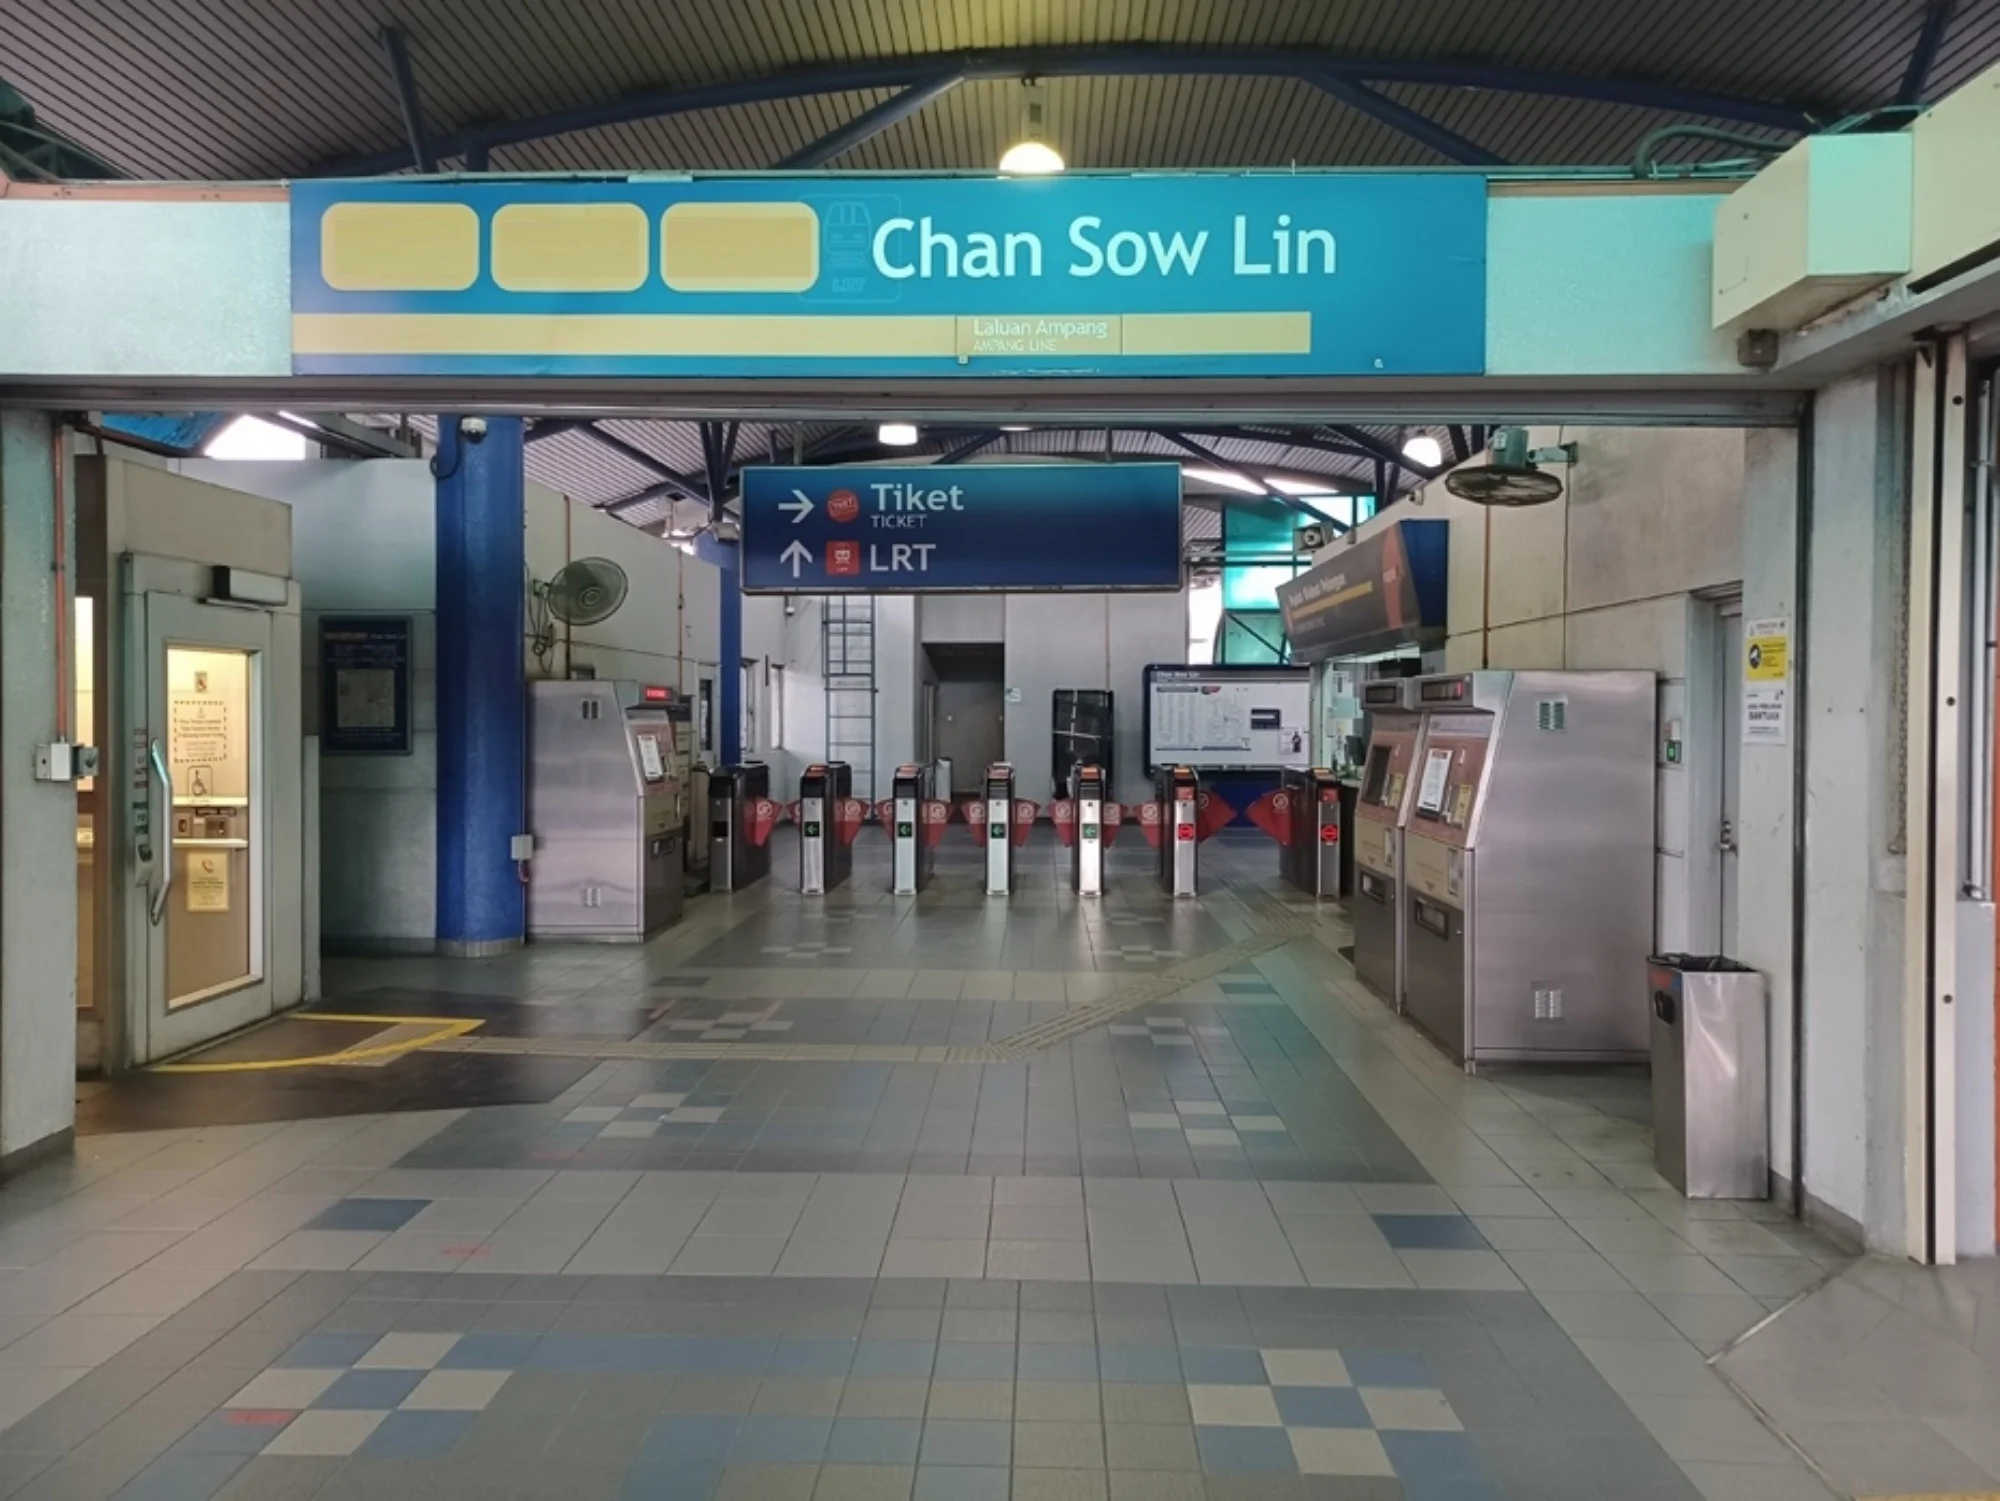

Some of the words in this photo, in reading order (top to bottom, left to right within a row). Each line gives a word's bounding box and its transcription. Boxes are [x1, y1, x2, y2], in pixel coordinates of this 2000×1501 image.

[872, 217, 1042, 279] Chan
[1068, 215, 1208, 277] Sow
[1233, 214, 1337, 275] Lin
[973, 319, 1031, 336] Laluan
[1035, 319, 1108, 339] Ampang
[973, 339, 1024, 352] AMPANG
[1029, 339, 1057, 352] LINE
[870, 483, 965, 512] Tiket
[870, 514, 928, 529] TICKET
[870, 543, 936, 572] LRT
